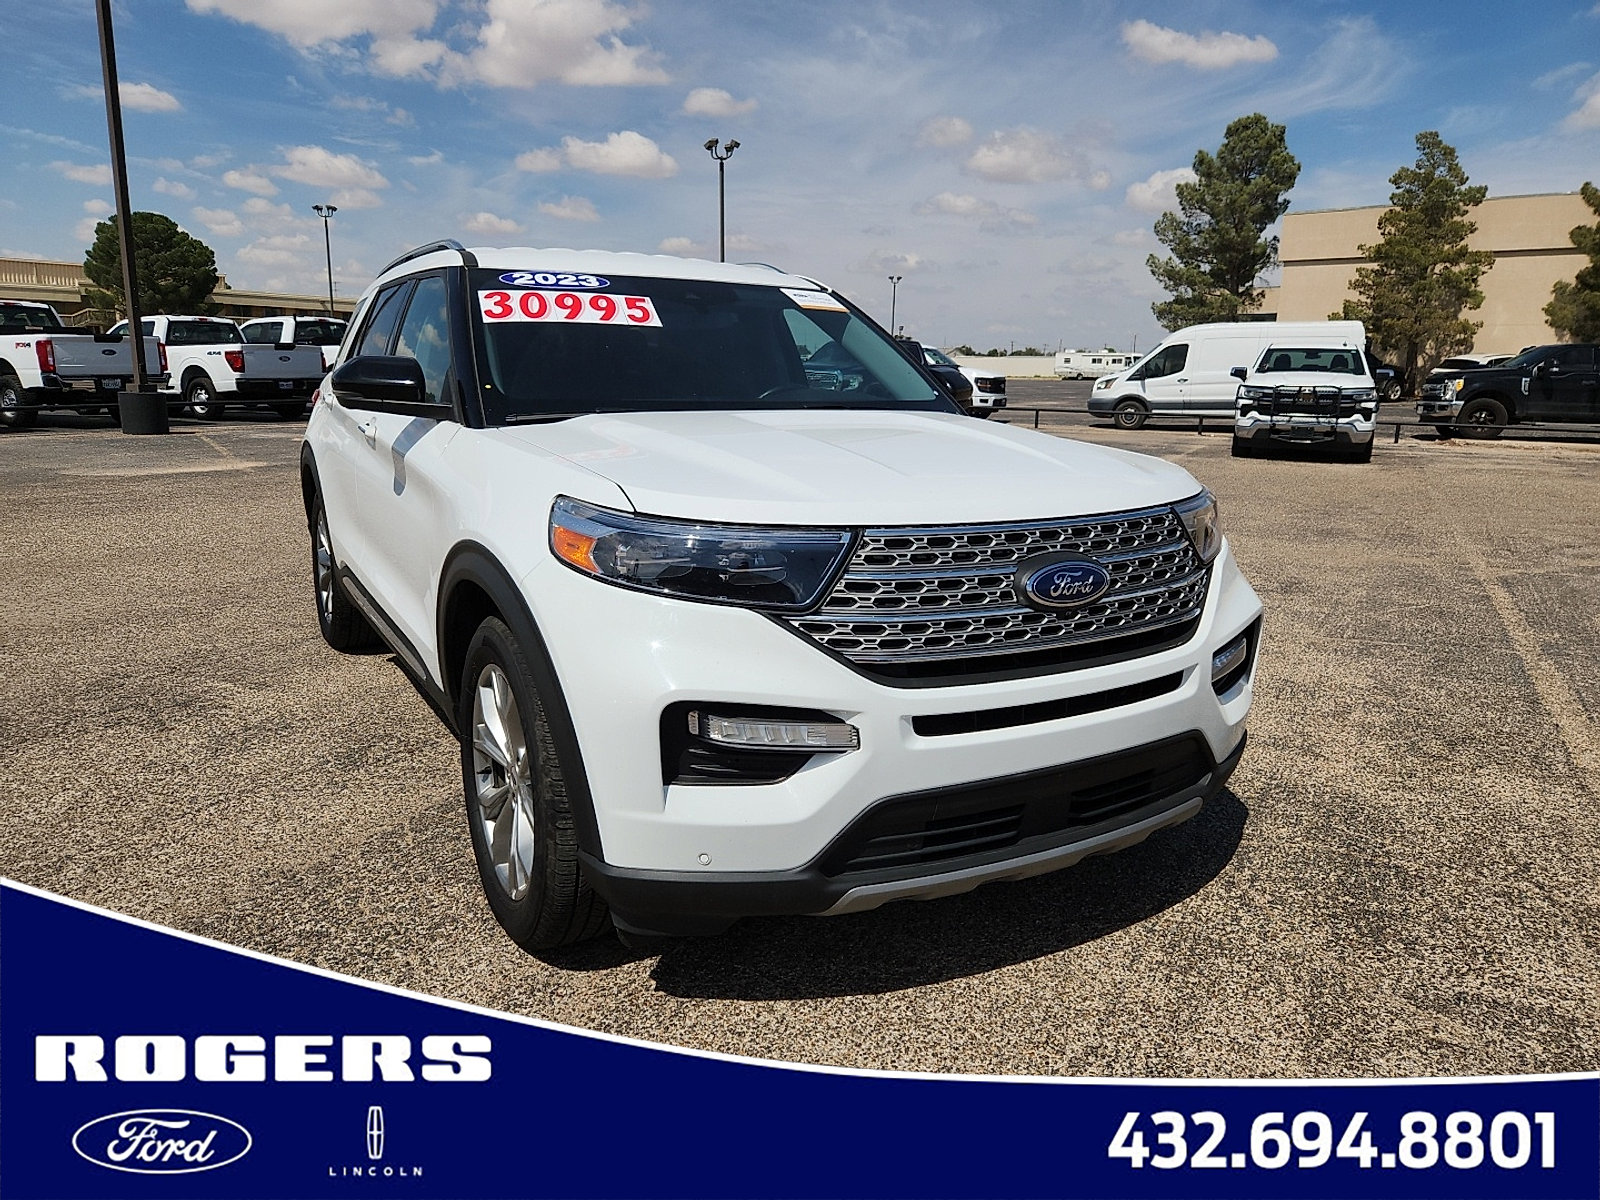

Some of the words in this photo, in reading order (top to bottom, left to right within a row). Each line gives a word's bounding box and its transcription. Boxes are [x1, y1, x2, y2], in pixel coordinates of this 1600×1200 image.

[512, 272, 600, 287] 2023
[484, 291, 652, 323] 30995
[1050, 571, 1095, 597] Ford
